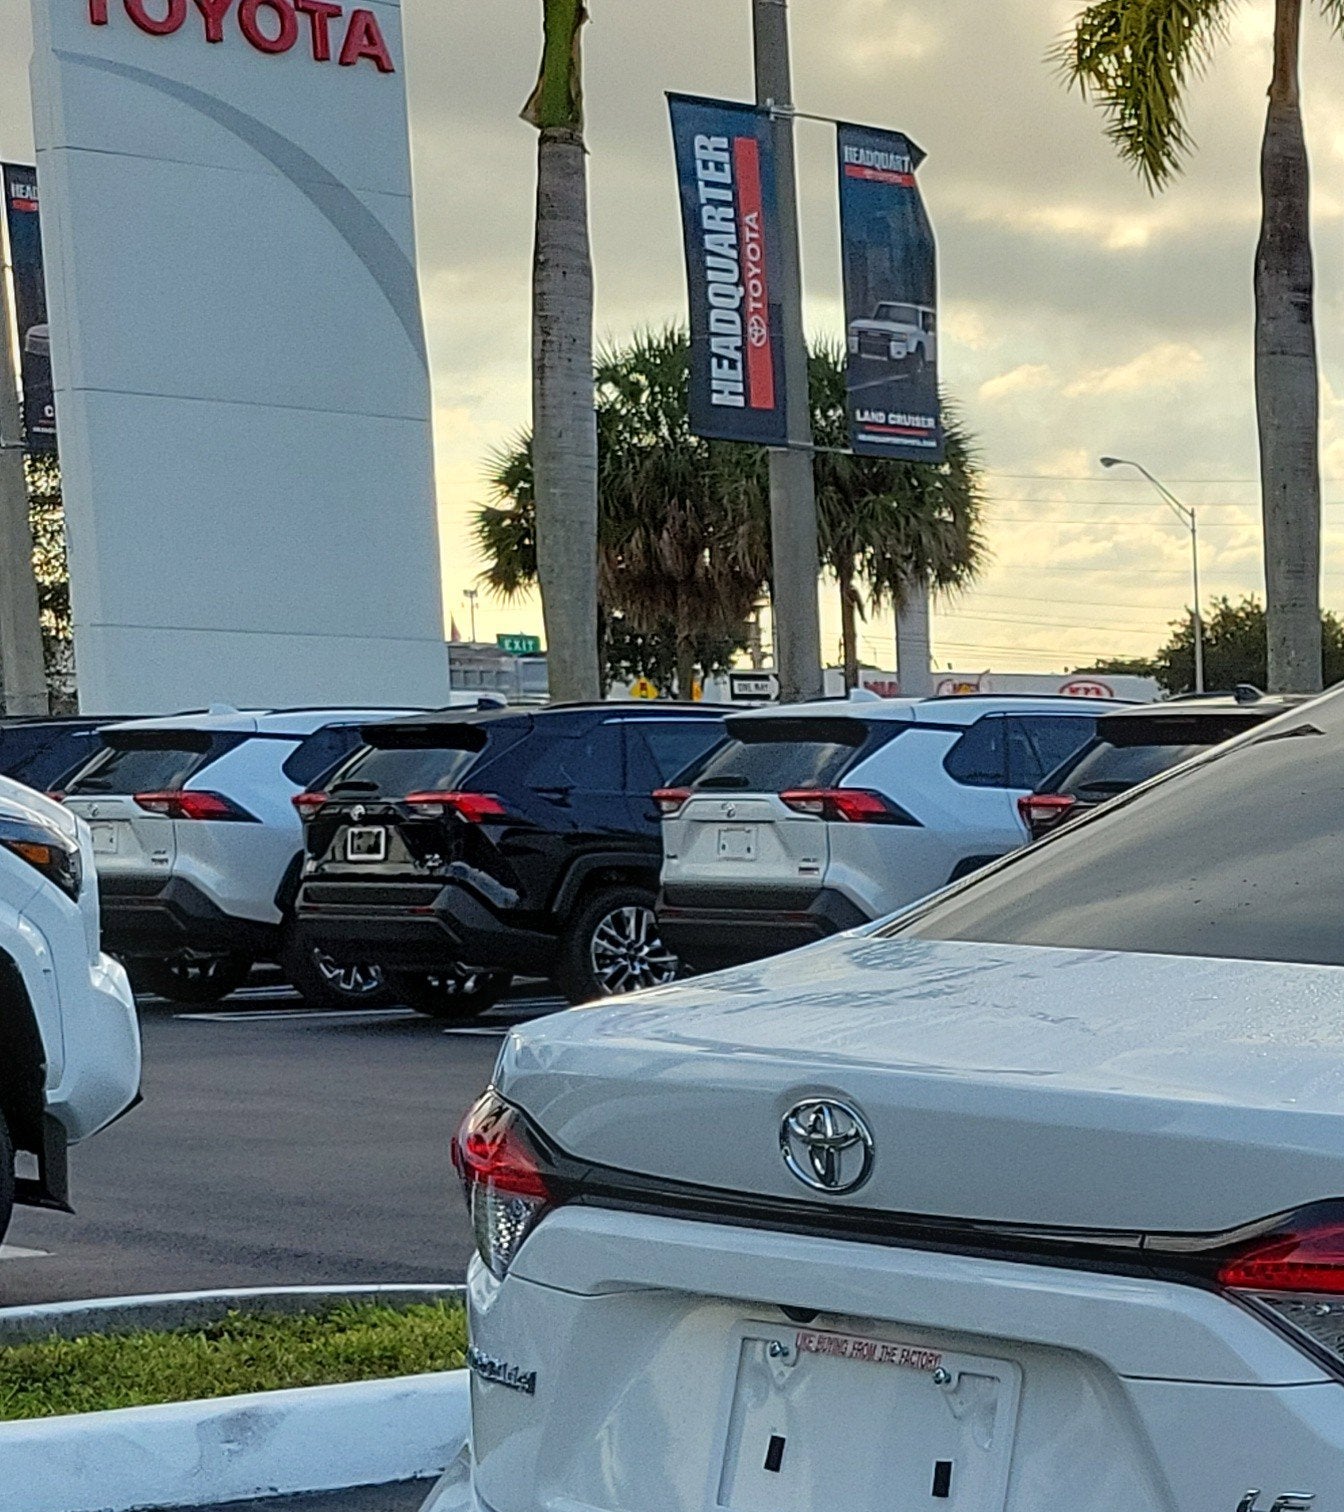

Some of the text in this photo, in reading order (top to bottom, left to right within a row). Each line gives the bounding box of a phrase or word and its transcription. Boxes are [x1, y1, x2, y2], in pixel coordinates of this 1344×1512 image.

[694, 134, 747, 409] HEADQUARTER
[745, 211, 764, 313] TOYOTA
[504, 638, 535, 651] EXIT
